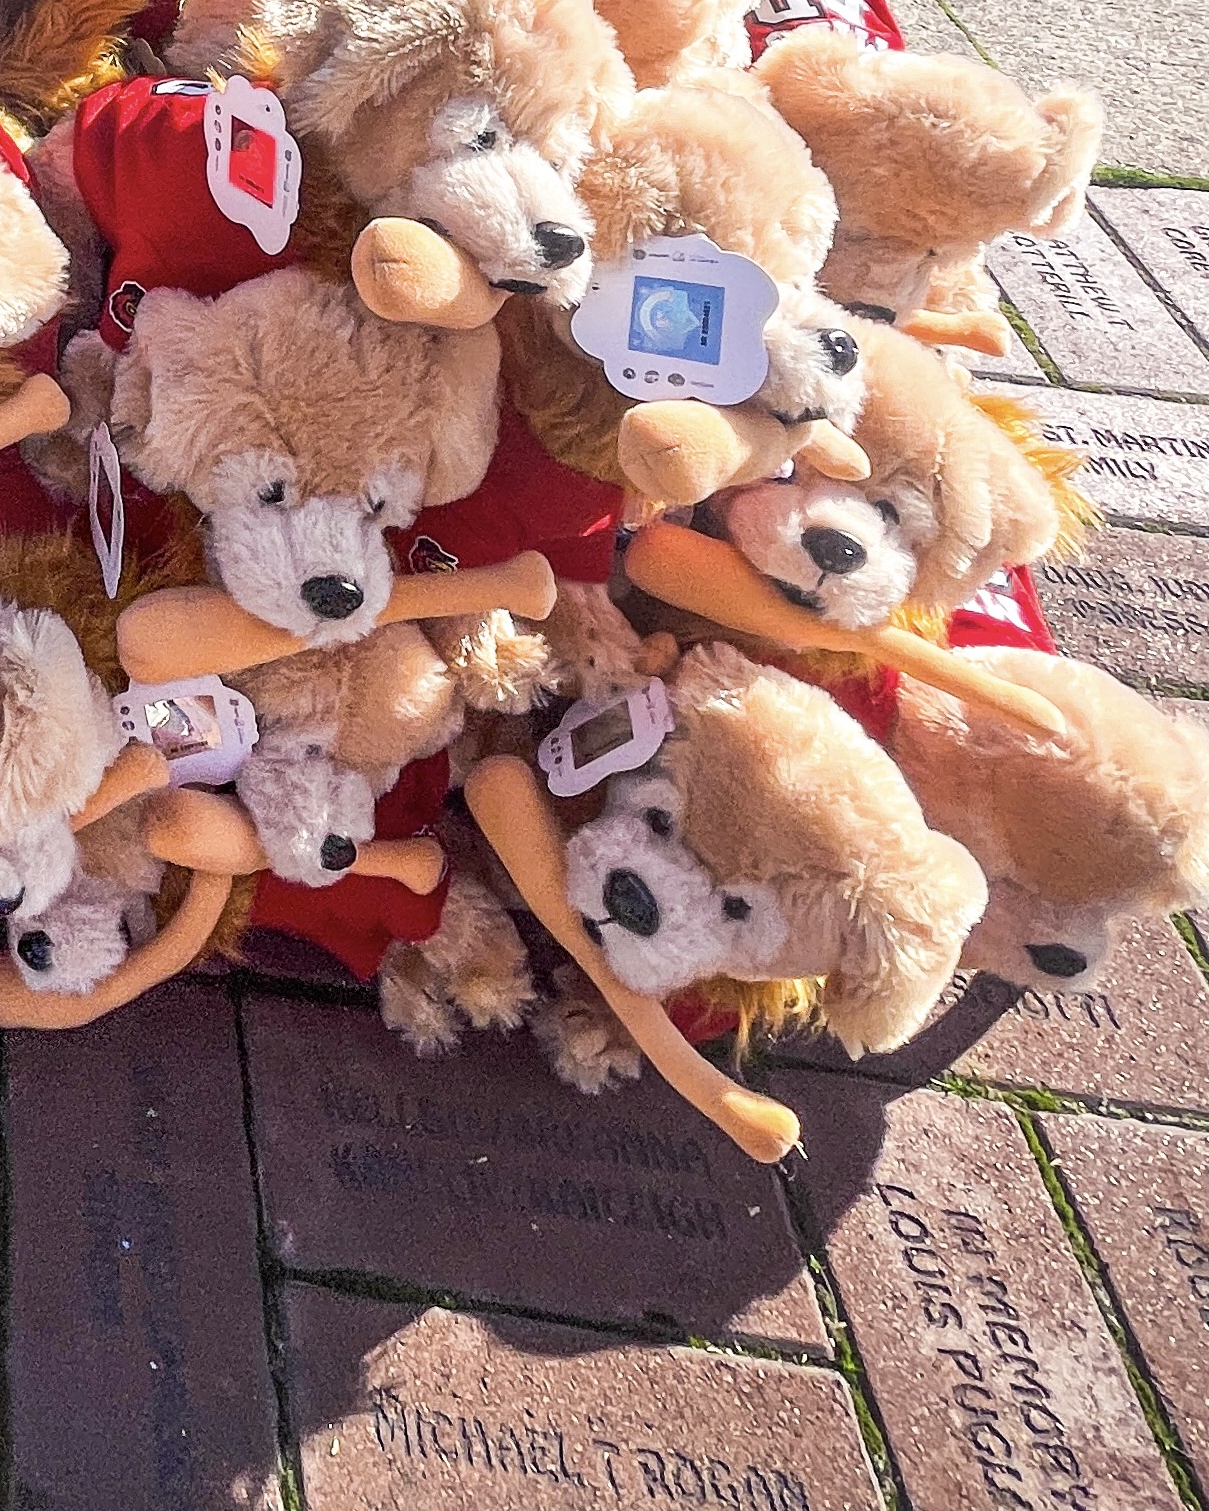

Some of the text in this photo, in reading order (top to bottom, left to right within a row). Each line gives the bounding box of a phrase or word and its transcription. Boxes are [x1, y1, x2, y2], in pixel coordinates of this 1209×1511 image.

[1010, 234, 1093, 320] OTTERILL
[1049, 239, 1121, 313] ATTHEW
[1042, 423, 1209, 460] ST. MARTIN
[1083, 454, 1159, 481] MILY
[876, 1183, 963, 1330] LOUIS
[967, 1275, 1095, 1511] MEMORY
[372, 1398, 589, 1489] MICHAEL
[636, 1447, 810, 1511] ROGAN
